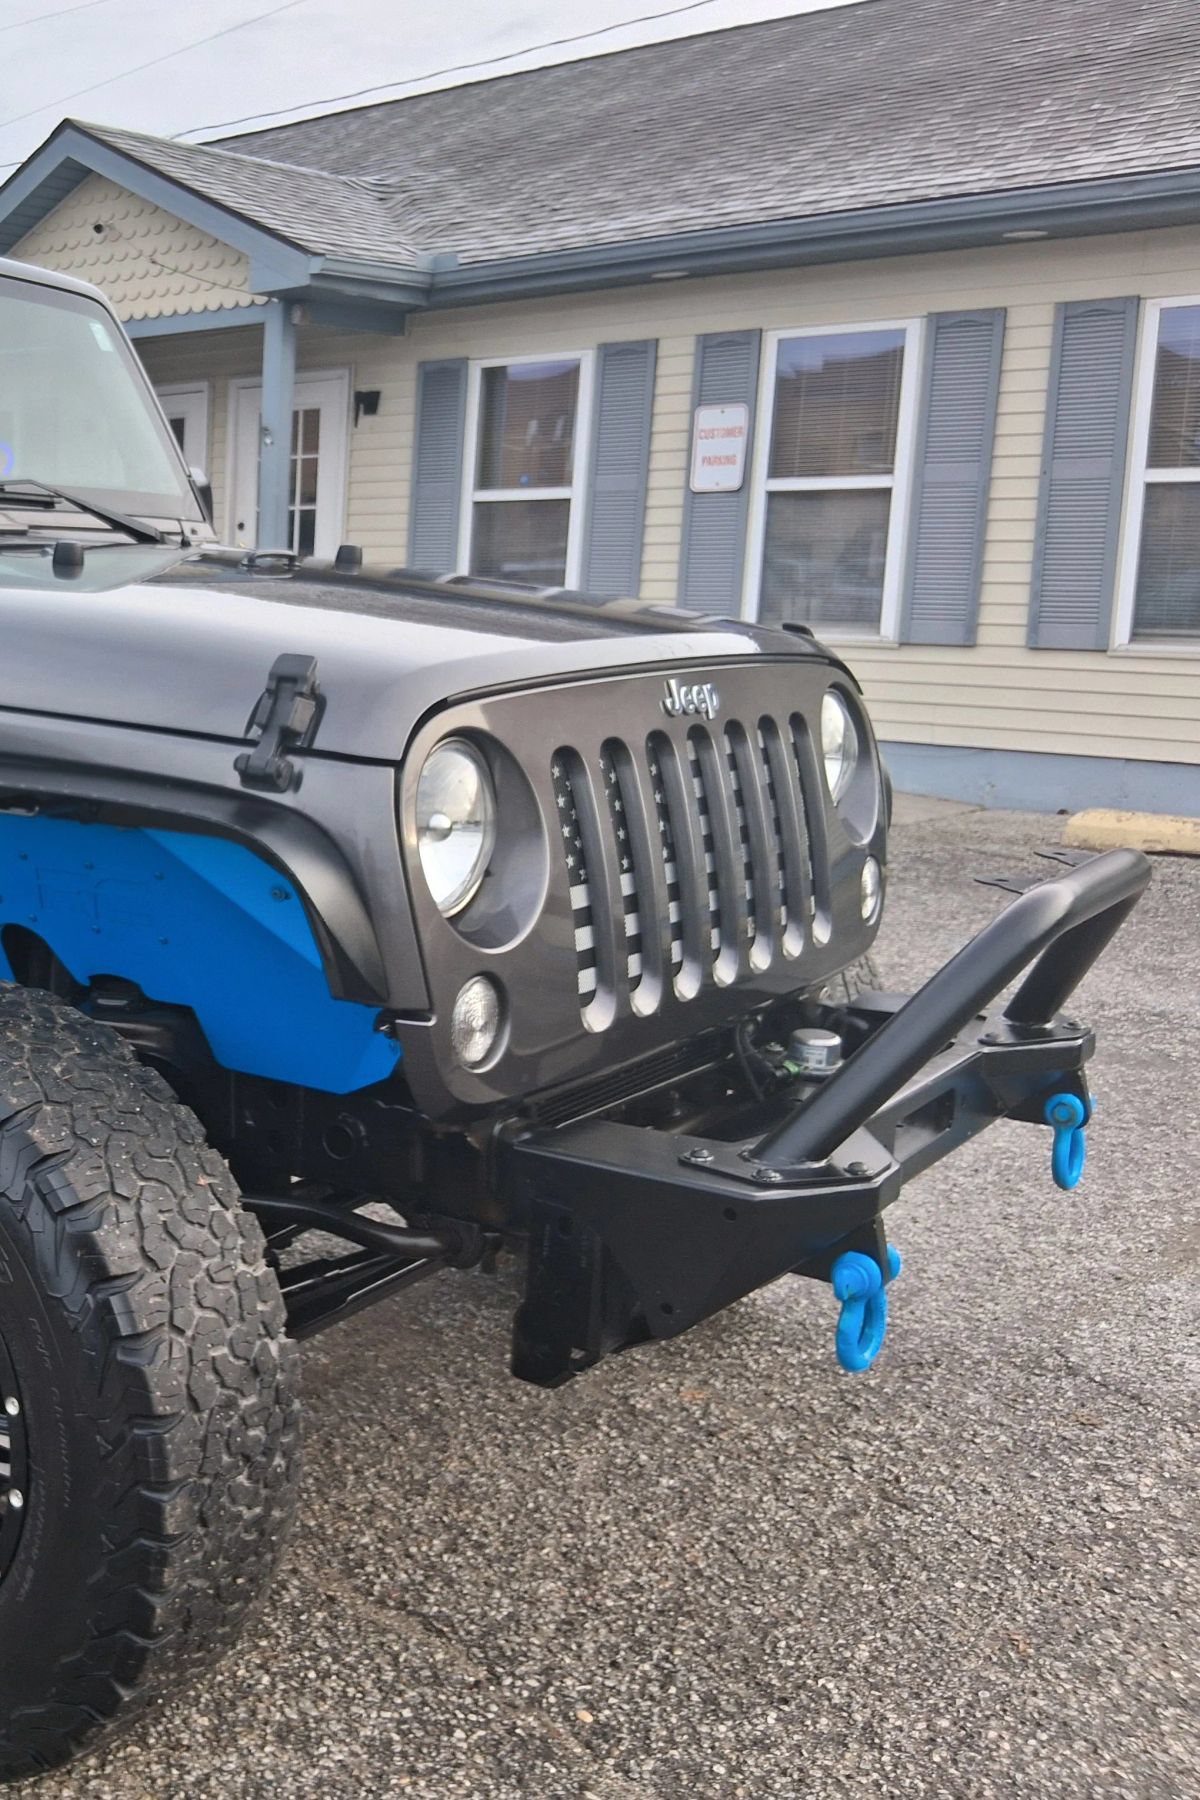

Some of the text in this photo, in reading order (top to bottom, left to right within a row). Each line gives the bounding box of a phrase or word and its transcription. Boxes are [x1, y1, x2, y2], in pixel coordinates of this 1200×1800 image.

[699, 426, 744, 440] CUSTOMER
[702, 454, 737, 467] PARKING
[659, 679, 719, 720] Jeep
